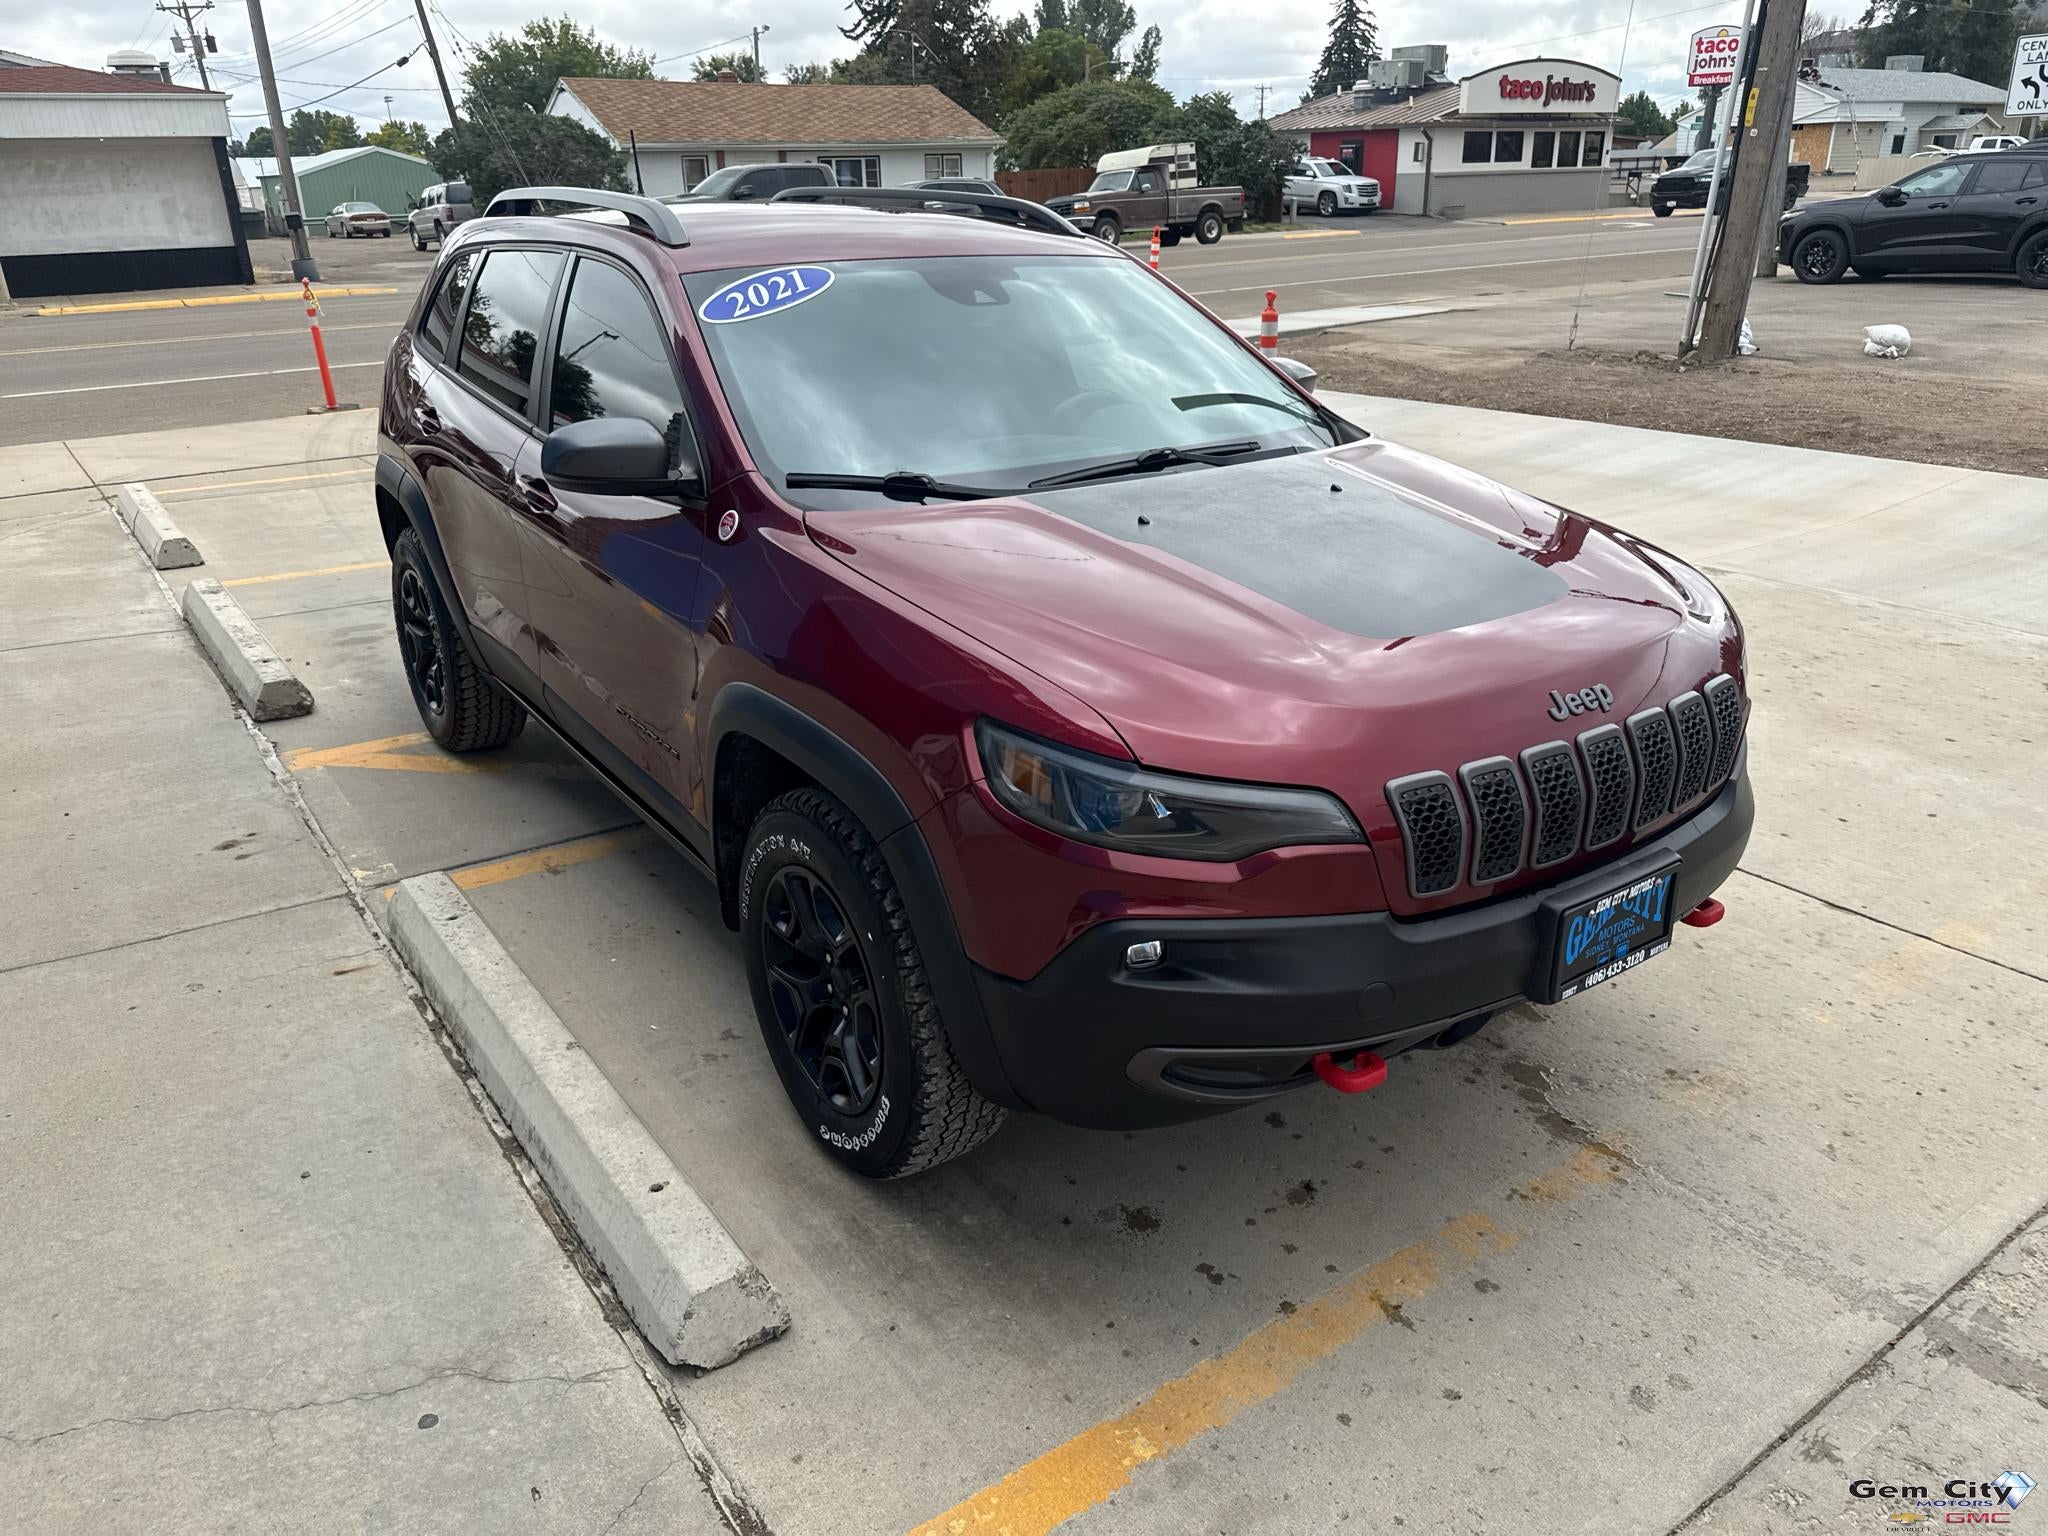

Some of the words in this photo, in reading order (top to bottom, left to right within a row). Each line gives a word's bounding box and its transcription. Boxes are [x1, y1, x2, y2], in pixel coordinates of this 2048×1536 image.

[1696, 37, 1739, 54] taco
[1692, 55, 1737, 73] john's
[1694, 75, 1731, 85] Breakfast
[1500, 75, 1544, 100] taco
[1543, 75, 1596, 107] john's
[2017, 99, 2048, 110] ONLY
[725, 270, 811, 318] 2021
[1547, 683, 1615, 722] Jeep
[742, 834, 785, 919] DESTINATION
[1595, 897, 1611, 914] GEM
[1611, 889, 1630, 908] CITY
[1628, 877, 1656, 900] MOTORS
[1599, 916, 1635, 941] MOTORS
[820, 1094, 890, 1151] Firestone
